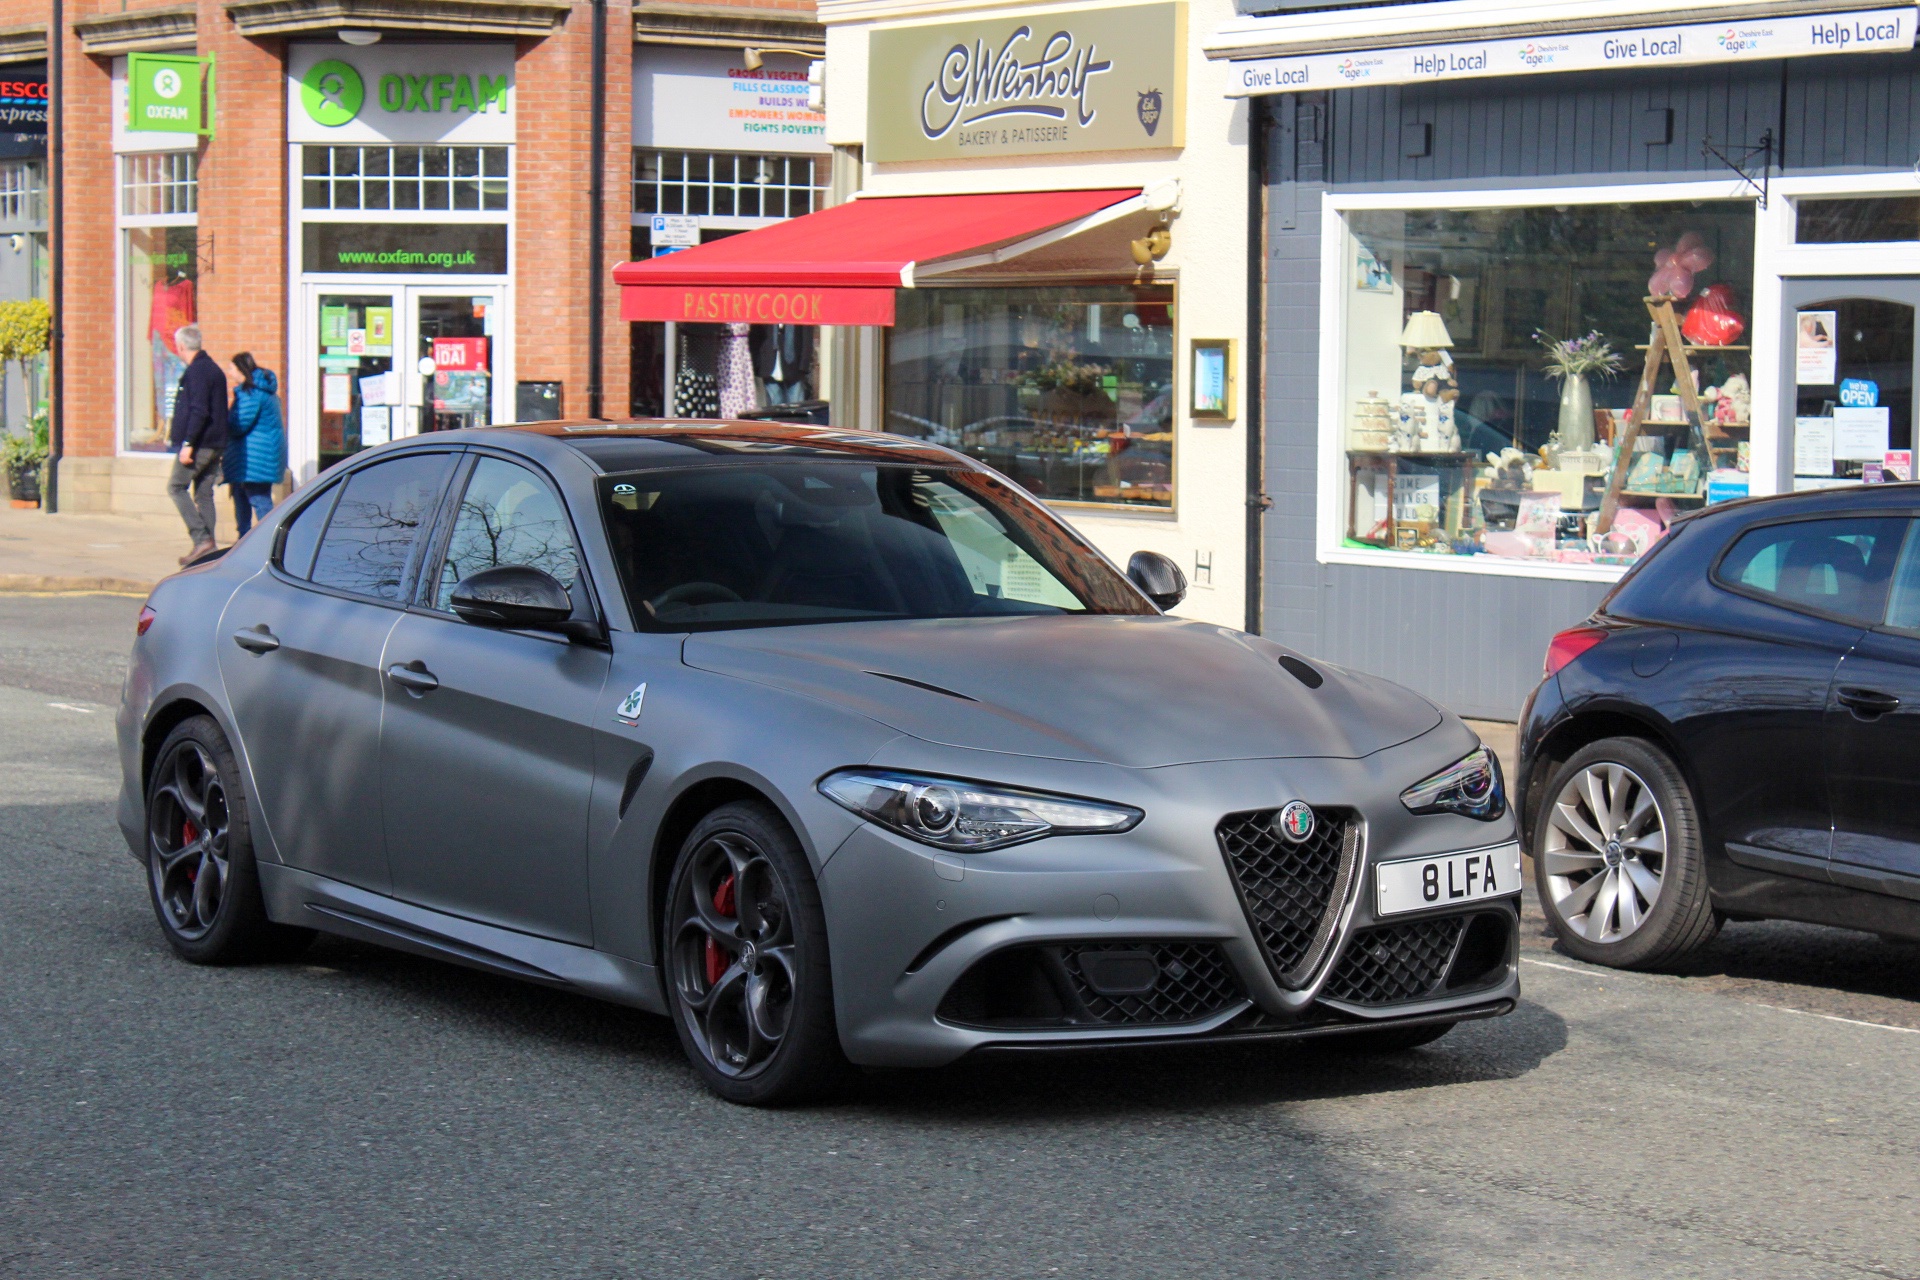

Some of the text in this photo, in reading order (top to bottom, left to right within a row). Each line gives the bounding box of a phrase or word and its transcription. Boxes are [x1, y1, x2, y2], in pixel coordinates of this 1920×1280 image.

[1739, 30, 1761, 38] Cheshire
[1812, 17, 1900, 48] Help Local
[1604, 34, 1682, 59] Give Local
[1414, 50, 1487, 77] Help Local
[727, 68, 765, 79] GROWS
[1243, 65, 1309, 87] Give Local
[0, 81, 48, 98] ESCO
[379, 73, 507, 113] OXFAM
[733, 82, 759, 92] FILLS
[759, 97, 793, 107] BUILDS
[0, 107, 48, 125] xpress
[146, 104, 188, 119] OXFAM
[729, 108, 825, 122] EMPOWERS WOMEN
[744, 123, 825, 135] FIGHTS POVERTY
[958, 126, 1068, 146] BAKERY & PATISSERIE
[338, 249, 476, 268] www.oxfam.org.uk
[684, 292, 822, 320] PASTRYCOOK
[435, 350, 466, 366] IDAI
[1849, 381, 1869, 391] we're
[1841, 389, 1875, 406] OPEN
[1394, 478, 1420, 489] SOME
[1393, 493, 1428, 504] HINGS
[1422, 854, 1497, 902] 8 LFA
